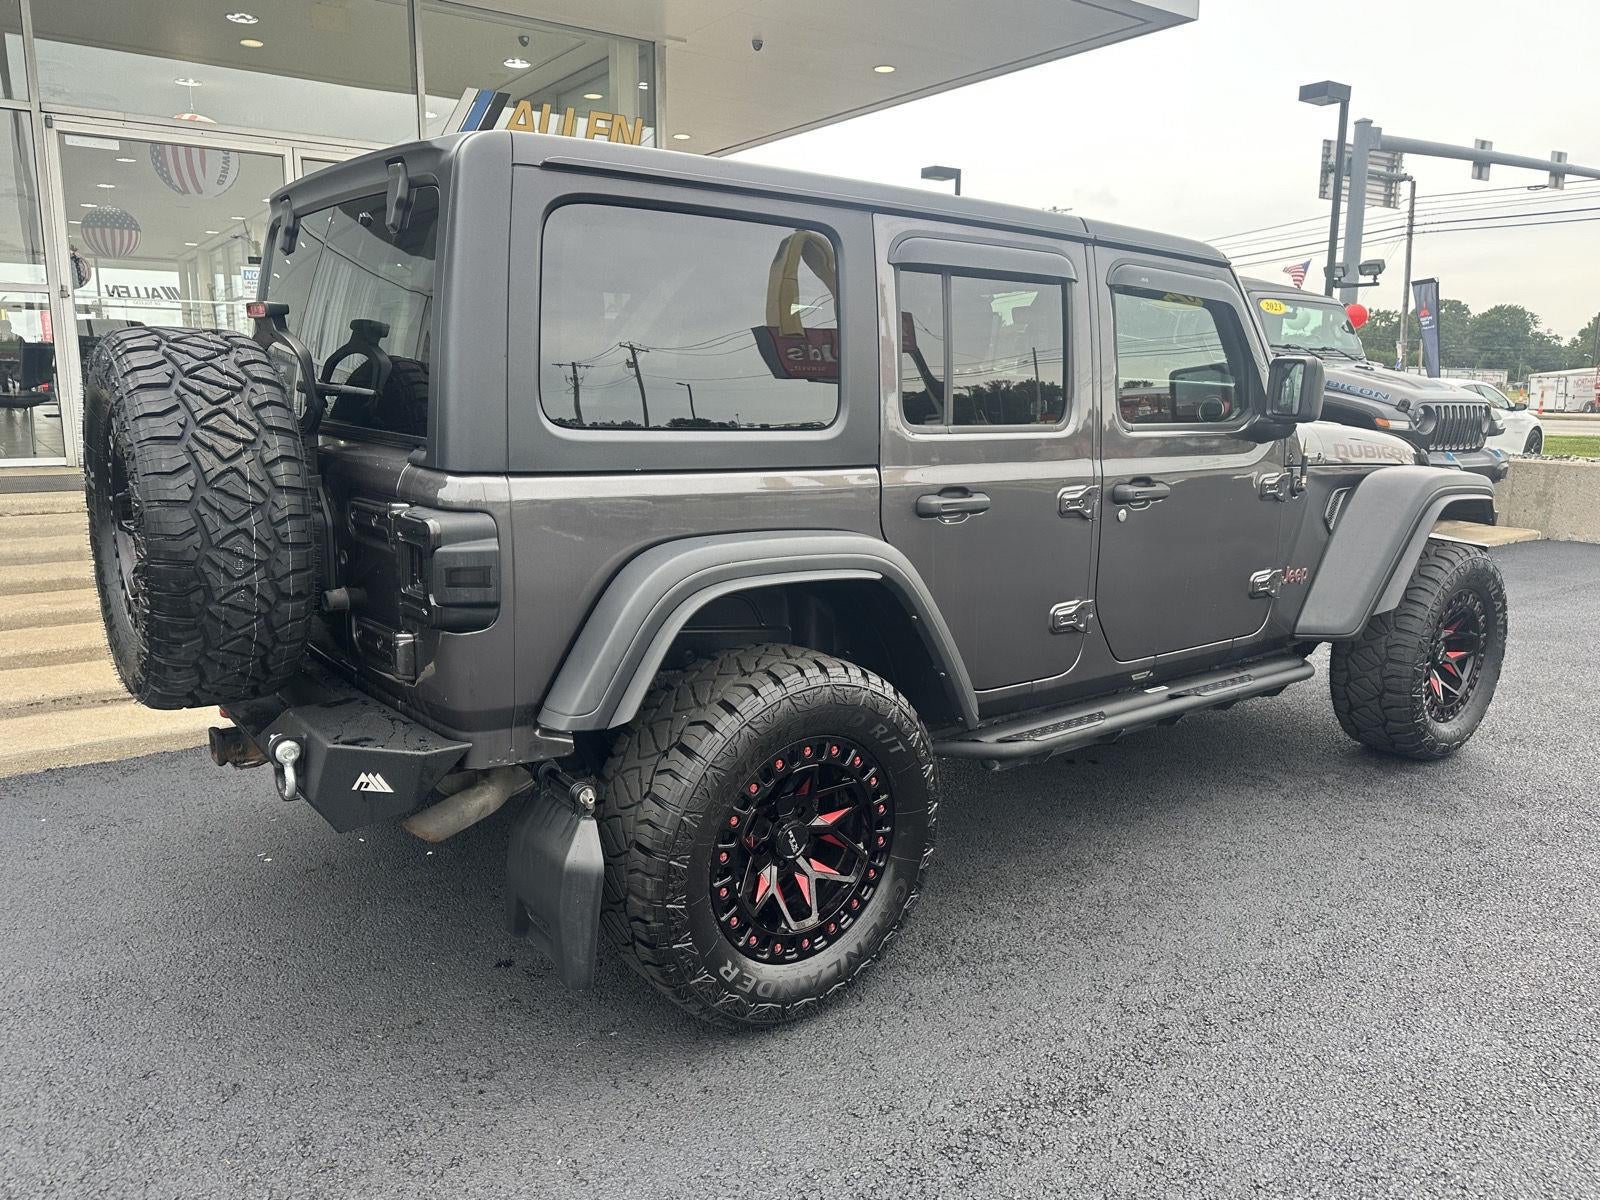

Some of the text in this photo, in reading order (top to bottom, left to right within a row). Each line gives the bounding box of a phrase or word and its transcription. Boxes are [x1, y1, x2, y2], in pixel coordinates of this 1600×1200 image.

[1265, 302, 1282, 312] 2023
[1325, 380, 1391, 401] BICON
[1333, 443, 1411, 463] RUBICON
[1283, 566, 1308, 584] Jeep
